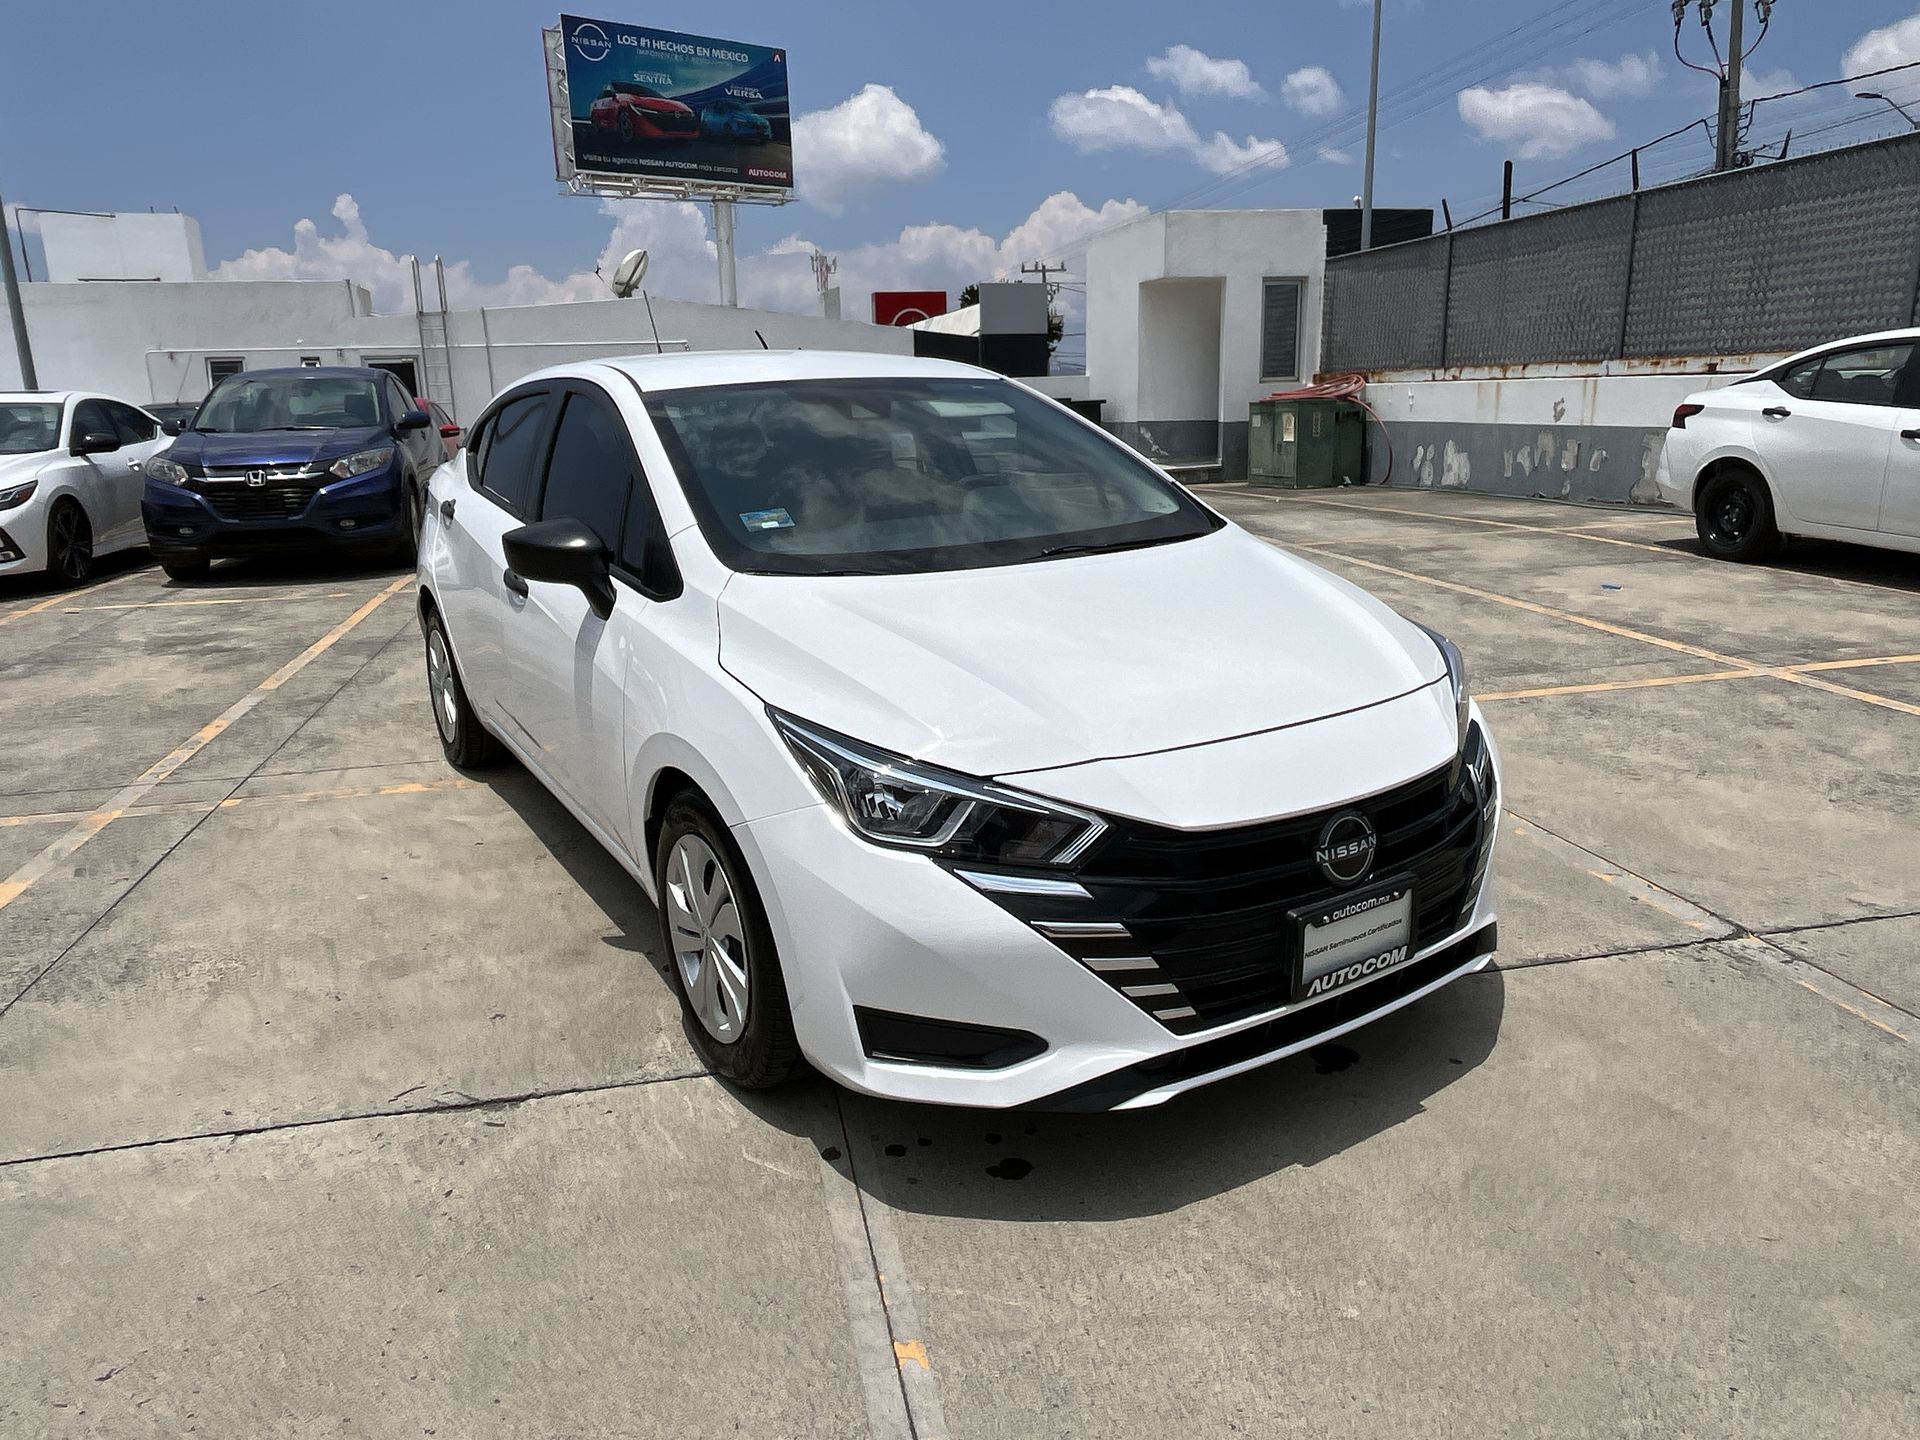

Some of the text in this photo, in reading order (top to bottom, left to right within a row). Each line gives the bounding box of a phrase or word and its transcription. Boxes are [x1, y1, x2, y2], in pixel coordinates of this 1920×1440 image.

[571, 36, 612, 48] NISSAN
[617, 34, 638, 46] LOS
[653, 39, 695, 55] HECHOS
[696, 46, 710, 57] EN
[633, 73, 673, 85] SENTRA
[724, 87, 764, 99] VERSA
[639, 158, 664, 167] NISSAN
[665, 160, 698, 170] AUTOCOM
[748, 168, 787, 179] AUTOCOM
[1316, 833, 1377, 863] NISSAN
[1332, 894, 1391, 920] autocom.mx
[1304, 944, 1329, 959] NISSAN
[1329, 932, 1367, 951] Seminuevos
[1306, 945, 1408, 998] AUTOCOM
